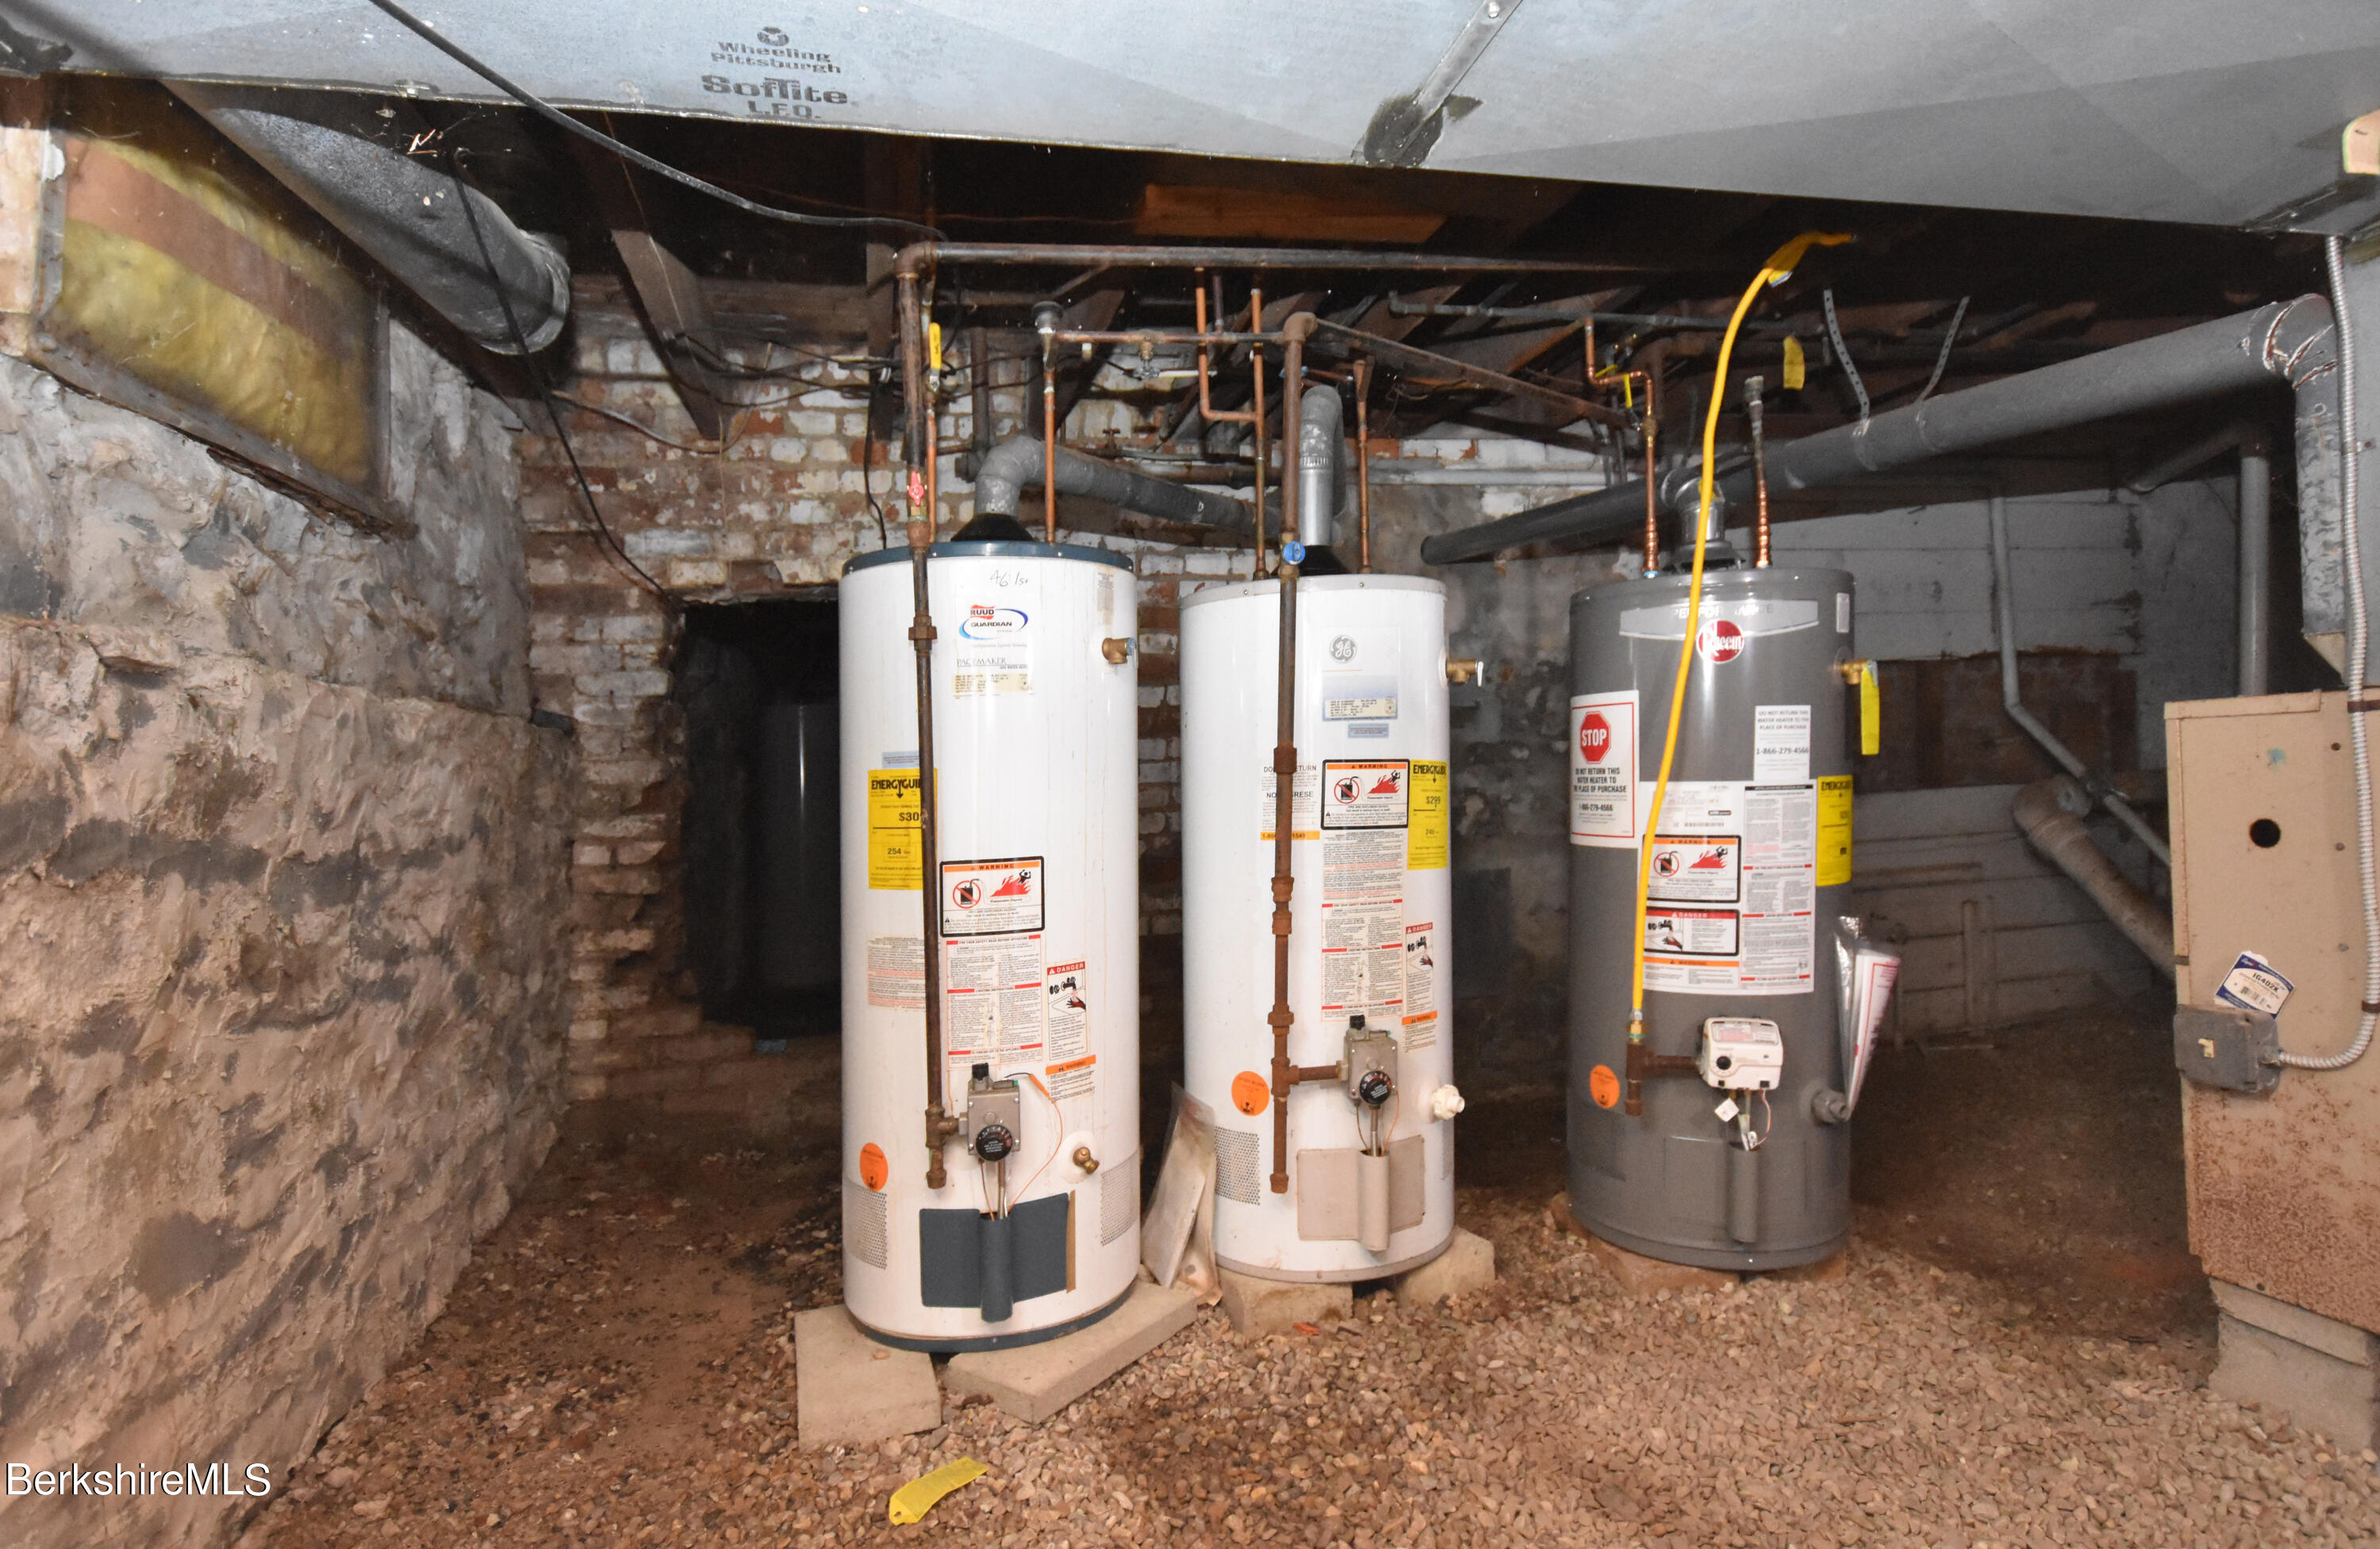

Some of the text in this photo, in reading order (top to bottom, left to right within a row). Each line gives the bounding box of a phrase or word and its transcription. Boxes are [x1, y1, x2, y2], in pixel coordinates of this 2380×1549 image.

[717, 41, 831, 63] Wheeling
[710, 52, 841, 74] Pittsburgh
[989, 569, 1008, 587] 46
[1581, 728, 1607, 747] STOP
[871, 778, 920, 790] ENERGYGUI
[1609, 775, 1617, 784] TO
[898, 812, 919, 822] $30
[1057, 963, 1084, 974] DANGER
